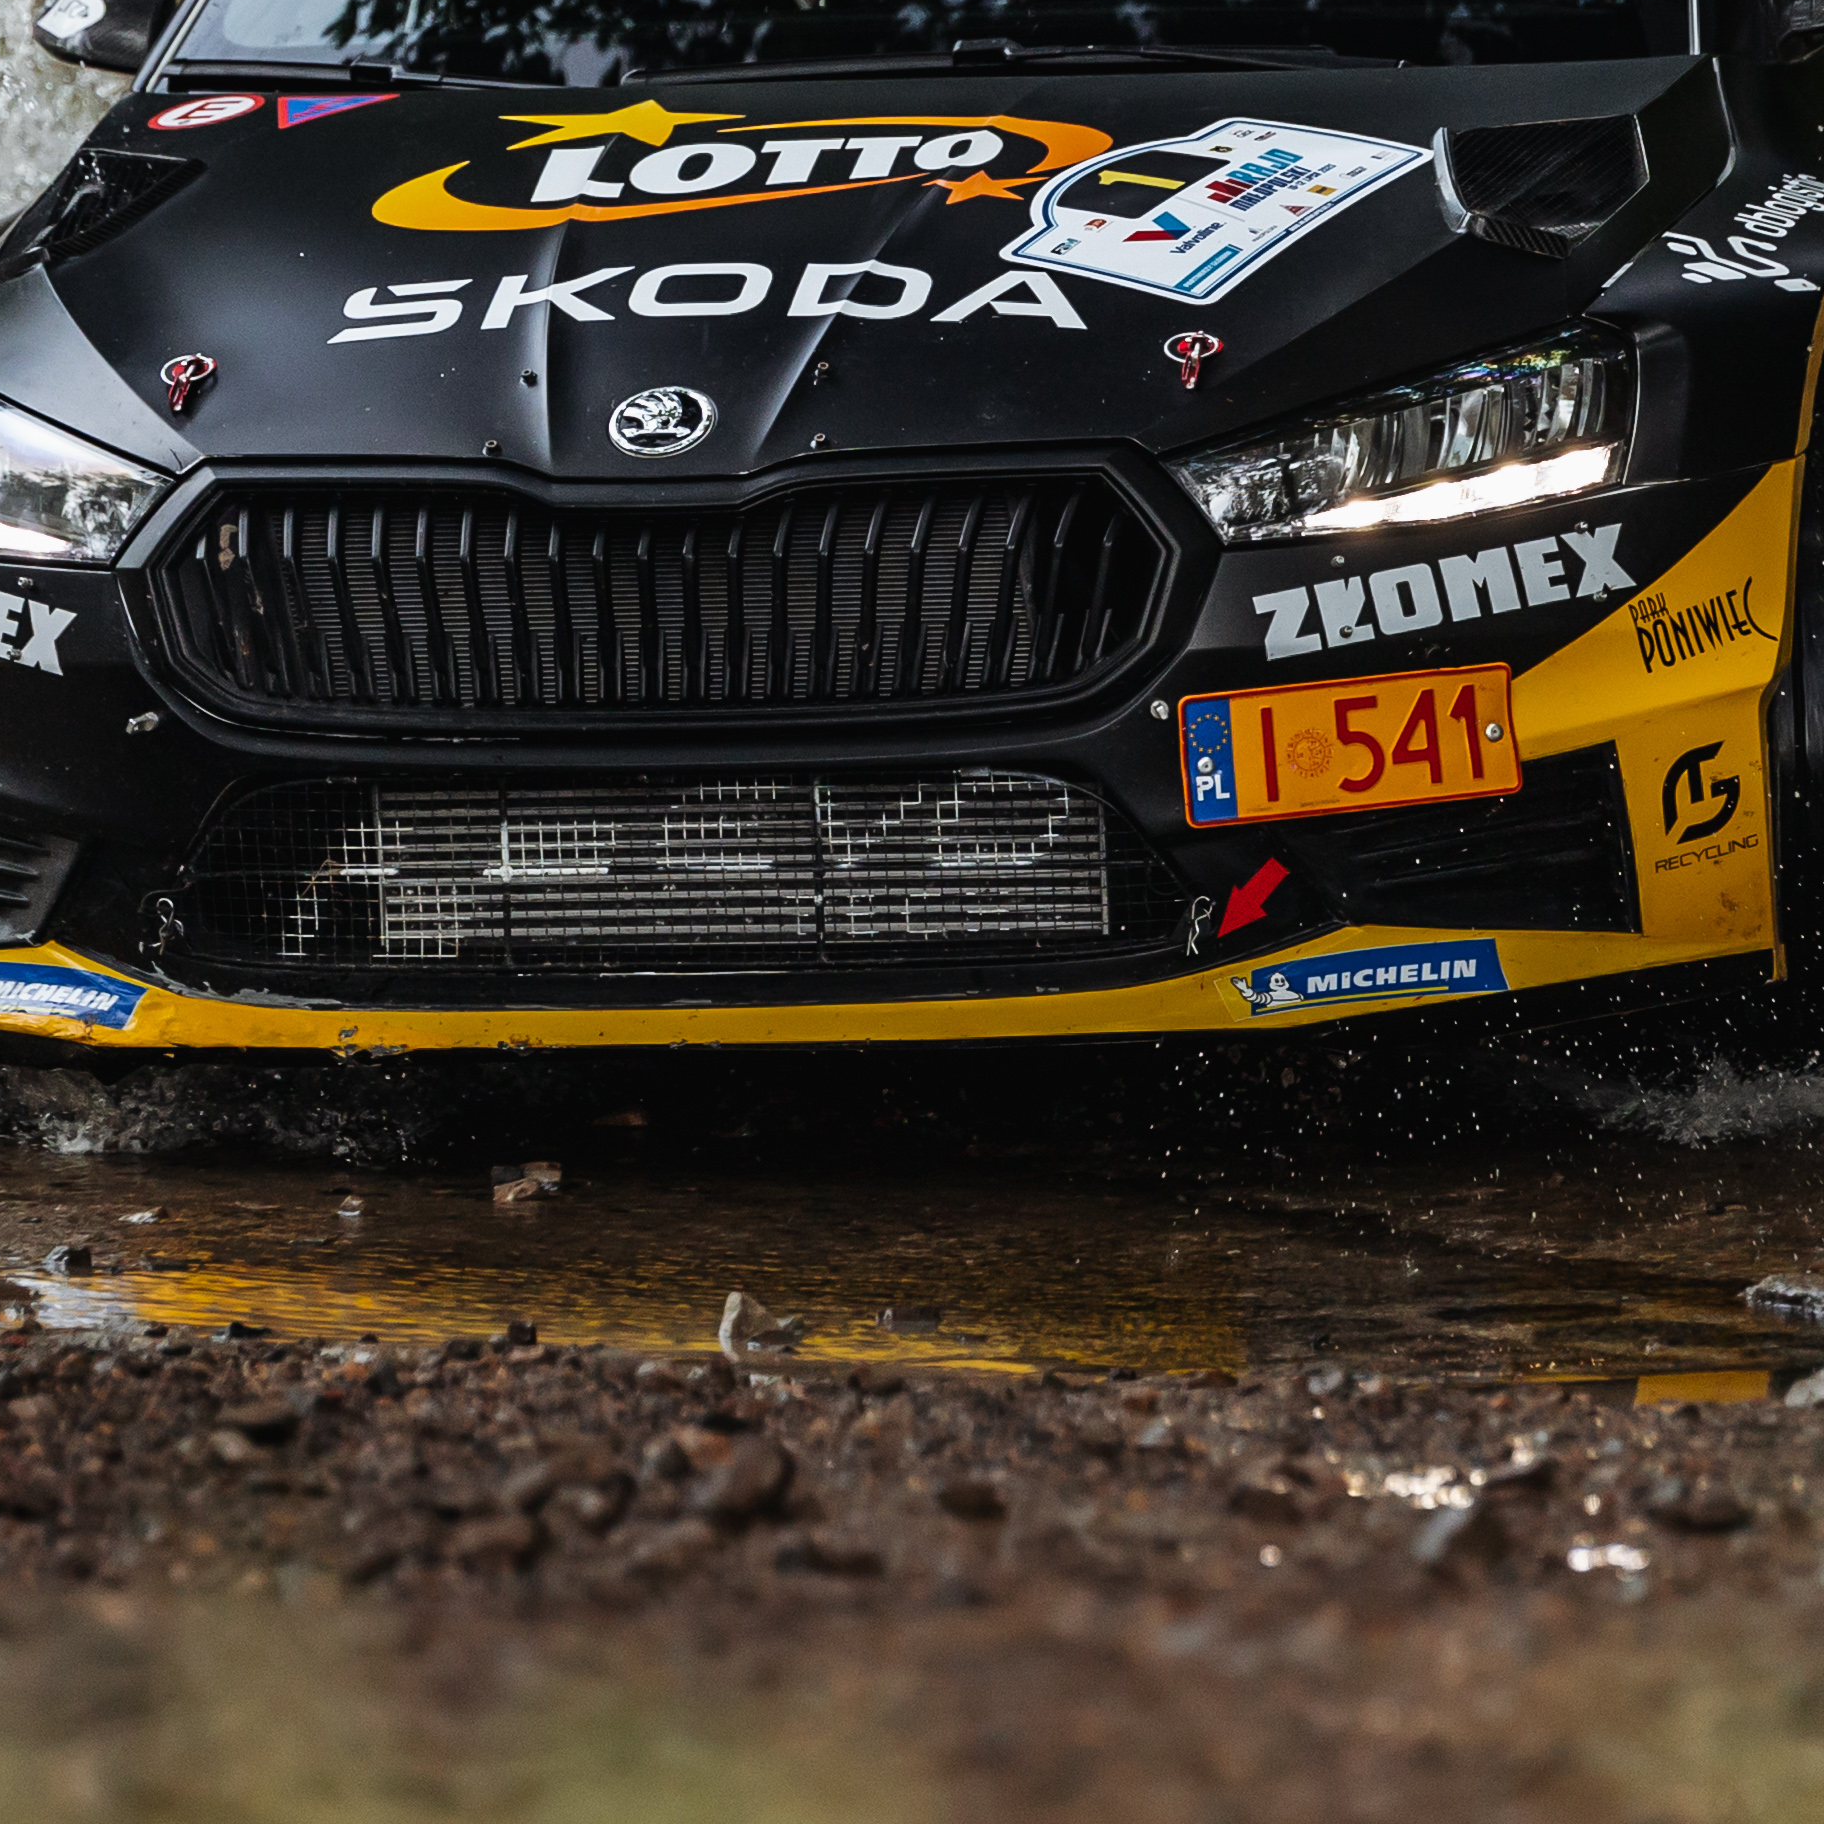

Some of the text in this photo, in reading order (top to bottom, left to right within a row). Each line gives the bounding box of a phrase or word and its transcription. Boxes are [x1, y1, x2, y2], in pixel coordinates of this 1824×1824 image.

[531, 131, 1004, 203] LOTTO
[1098, 170, 1186, 190] 1
[1170, 221, 1226, 255] Valvoline
[327, 262, 1088, 344] SKODA
[1334, 684, 1485, 794] 541
[1195, 773, 1230, 802] PL
[1655, 834, 1759, 874] RECYCLING
[1307, 959, 1477, 993] MICHELIN
